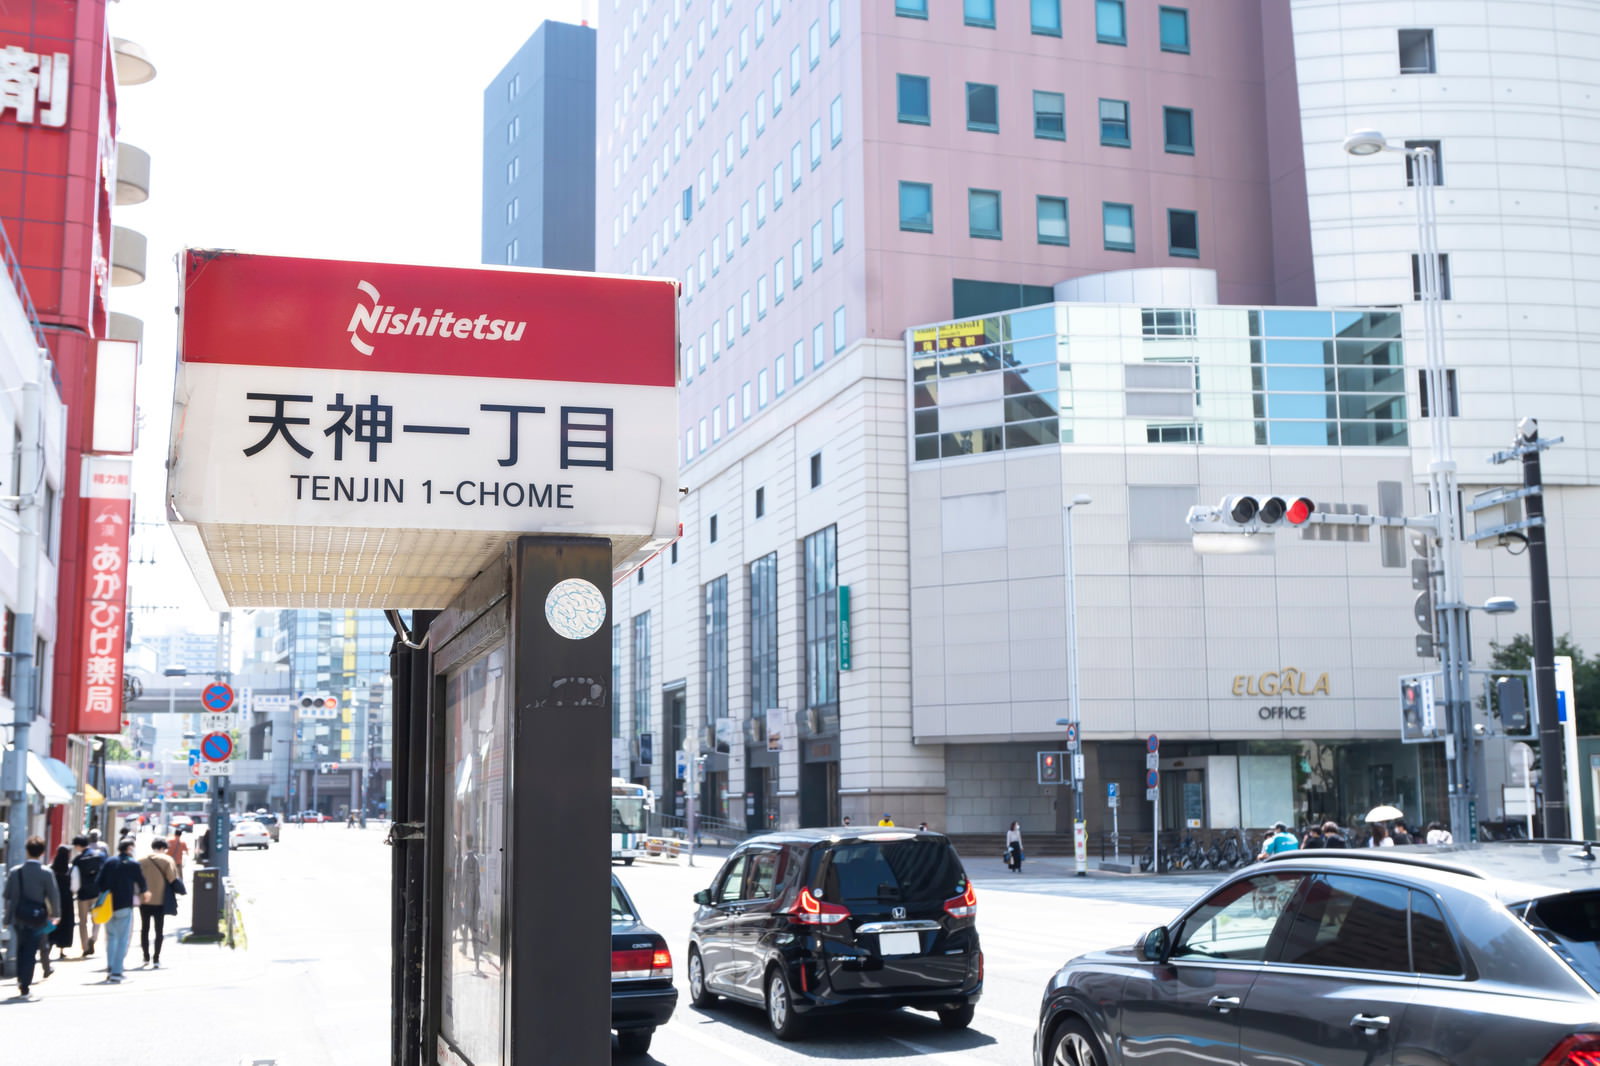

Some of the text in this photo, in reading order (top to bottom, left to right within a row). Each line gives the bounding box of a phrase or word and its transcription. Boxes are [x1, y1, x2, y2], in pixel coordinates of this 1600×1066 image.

[346, 280, 526, 356] Nishitetsu
[242, 392, 614, 471] 天神一丁目
[290, 475, 574, 509] TENJIN 1-CHOME
[85, 543, 121, 714] あかひげ薬局
[1258, 706, 1306, 720] OFFICE
